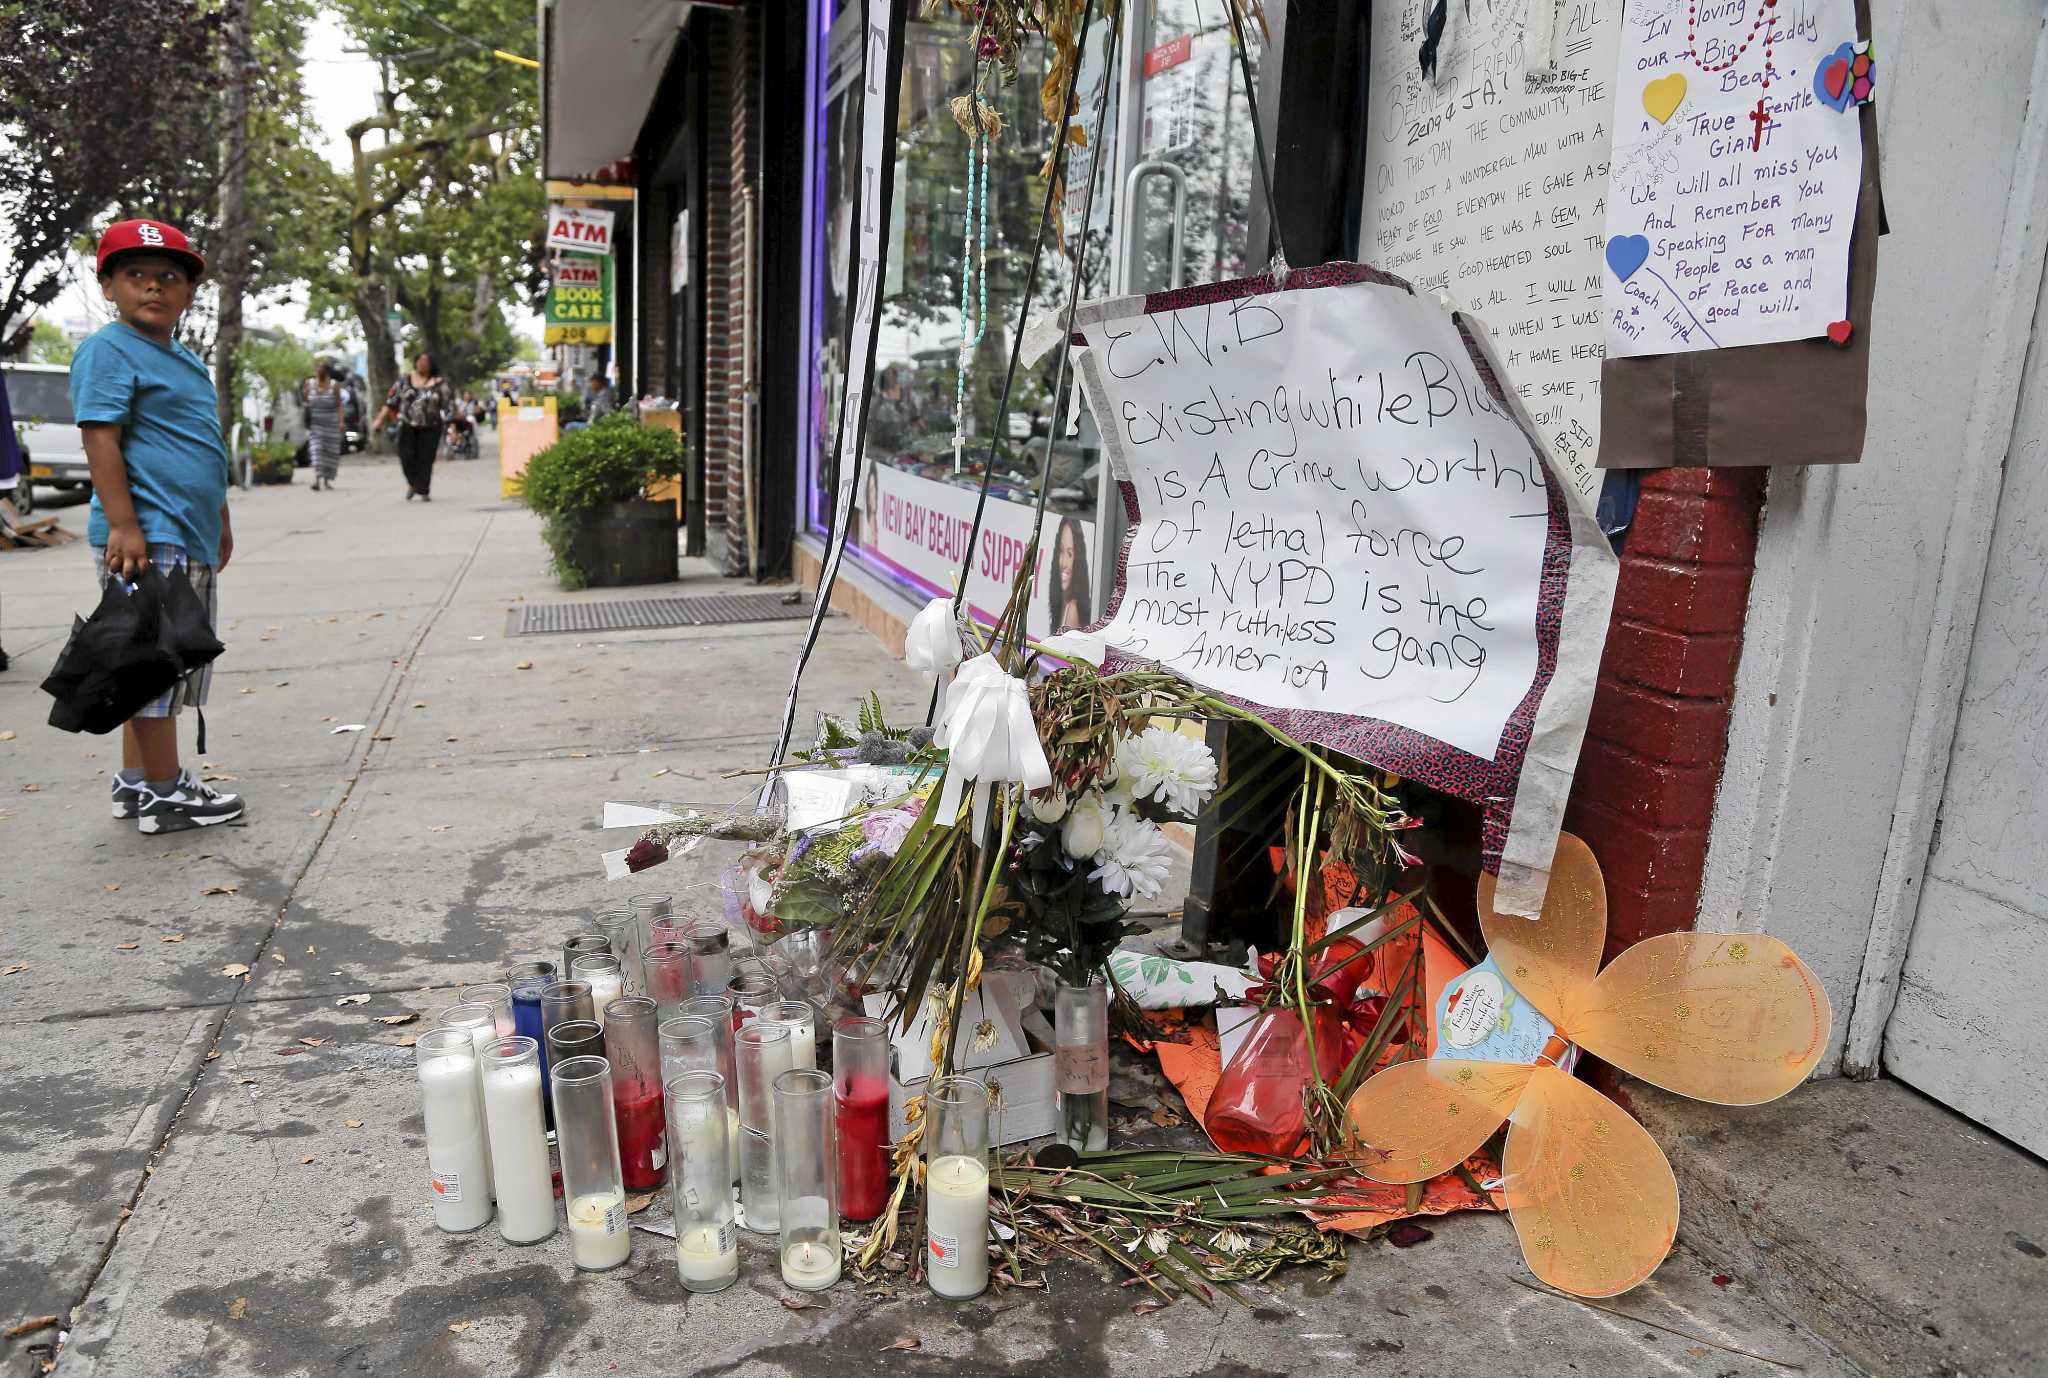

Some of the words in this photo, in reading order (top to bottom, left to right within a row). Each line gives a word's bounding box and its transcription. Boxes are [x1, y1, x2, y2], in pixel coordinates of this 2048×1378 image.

[1465, 120, 1489, 144] THE
[1578, 82, 1606, 106] THE
[1415, 185, 1437, 205] LOST
[1459, 156, 1519, 184] WONDERFUL
[1524, 142, 1548, 162] MAN
[1558, 130, 1585, 150] WITH
[1593, 122, 1605, 140] A
[1631, 185, 1657, 205] We
[1718, 162, 1742, 188] all
[1376, 226, 1402, 247] HEART
[1408, 219, 1419, 233] OF
[1456, 191, 1506, 217] EVERYDAY
[1517, 181, 1533, 202] HE
[1543, 171, 1575, 195] GAVE
[1584, 164, 1594, 182] A
[1644, 203, 1677, 232] And
[553, 219, 609, 245] ATM
[1432, 241, 1445, 256] HE
[1480, 225, 1495, 241] HE
[1502, 219, 1524, 236] WAS
[1532, 210, 1543, 231] A
[1592, 197, 1606, 216] A
[1543, 241, 1573, 259] SOUL
[1653, 231, 1727, 261] Speaking
[559, 268, 599, 282] ATM
[1675, 254, 1721, 282] People
[1734, 256, 1753, 270] as
[1762, 253, 1774, 266] a
[1782, 268, 1813, 291] and
[555, 287, 603, 302] BOOK
[1470, 298, 1483, 311] US
[1525, 283, 1537, 298] I
[1547, 279, 1577, 294] WILL
[1624, 281, 1661, 310] Coach
[553, 303, 604, 320] CAFE
[1508, 317, 1545, 337] WHEN
[1551, 315, 1567, 329] I
[1612, 309, 1645, 341] Roni
[1705, 298, 1741, 324] good
[1506, 349, 1523, 369] AT
[1146, 467, 1187, 505] is
[1198, 451, 1232, 499] A
[882, 490, 901, 537] NEW
[904, 501, 928, 547] BAY
[981, 528, 1045, 599] SUPPY
[1224, 510, 1326, 564] lethal
[1346, 499, 1485, 576] force
[1210, 558, 1336, 608] NYPD
[1361, 570, 1403, 614] is
[1420, 575, 1496, 632] the
[1360, 628, 1488, 704] gang
